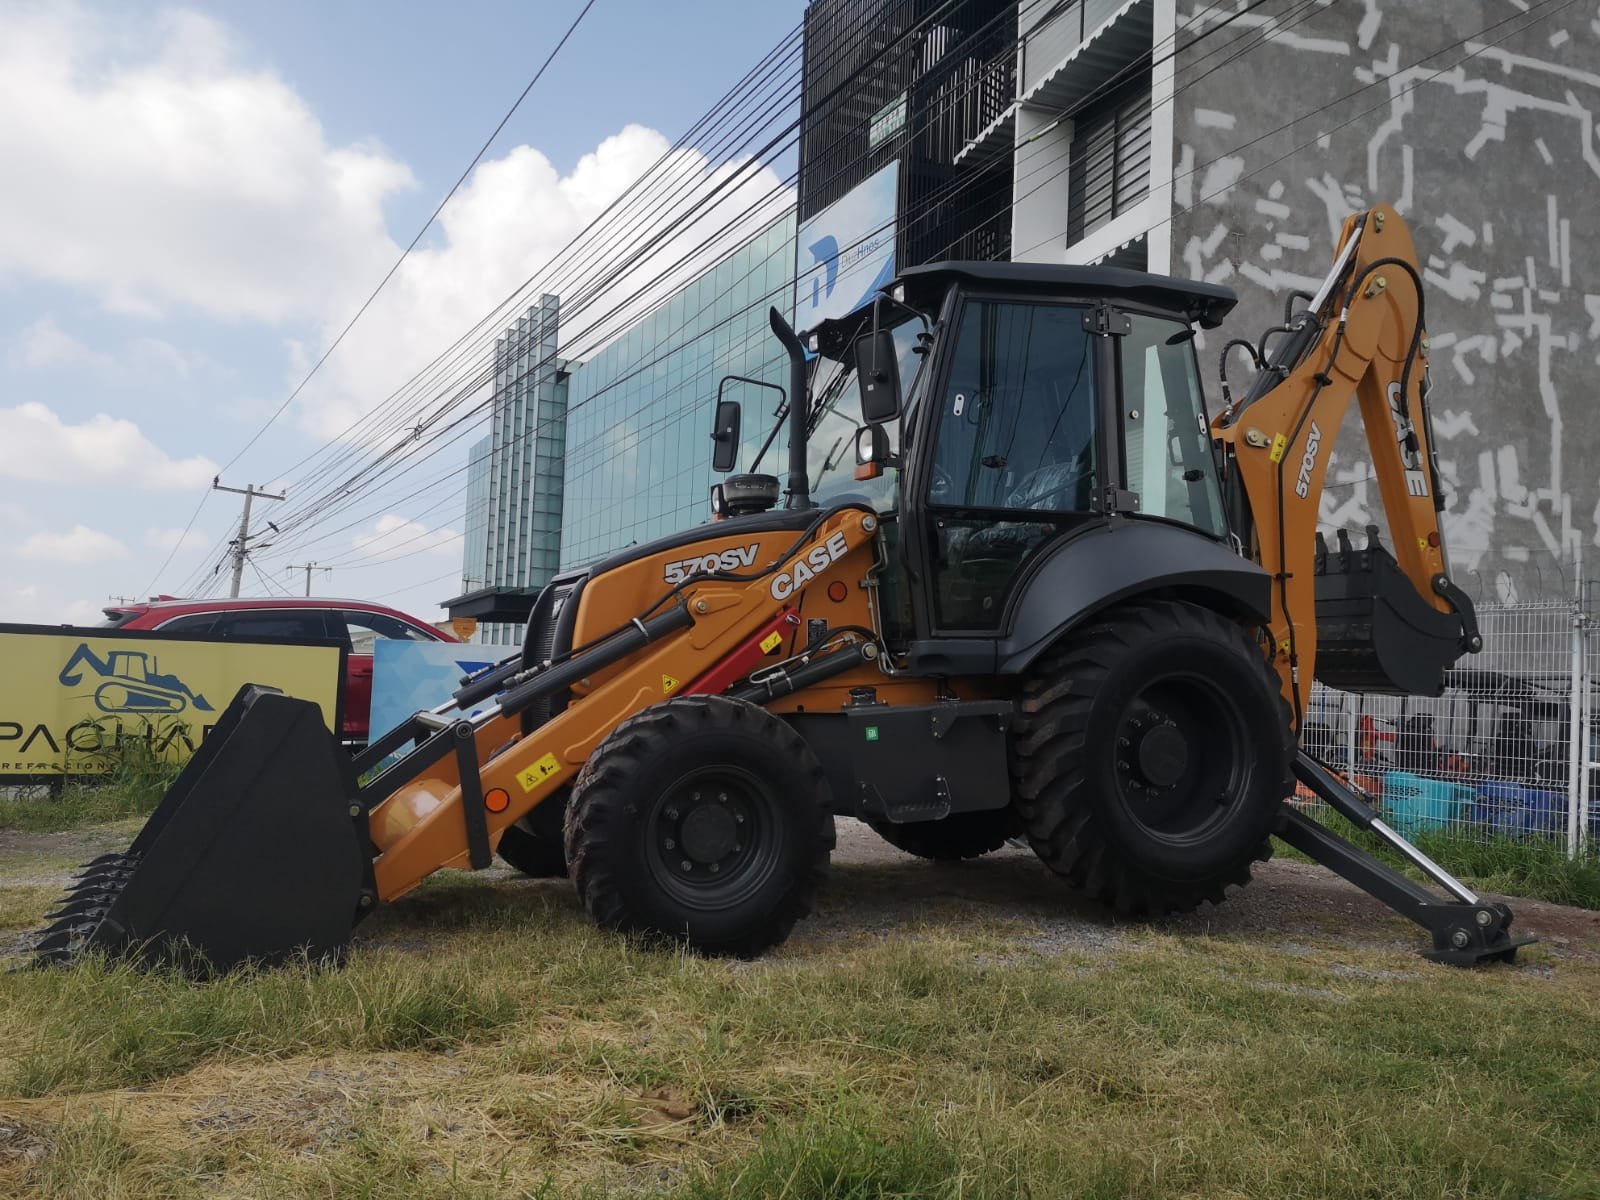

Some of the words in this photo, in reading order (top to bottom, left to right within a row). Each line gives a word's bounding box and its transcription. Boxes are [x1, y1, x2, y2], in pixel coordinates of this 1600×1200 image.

[1296, 420, 1321, 499] 570SV
[664, 543, 759, 585] 570SV
[770, 531, 849, 600] CASE
